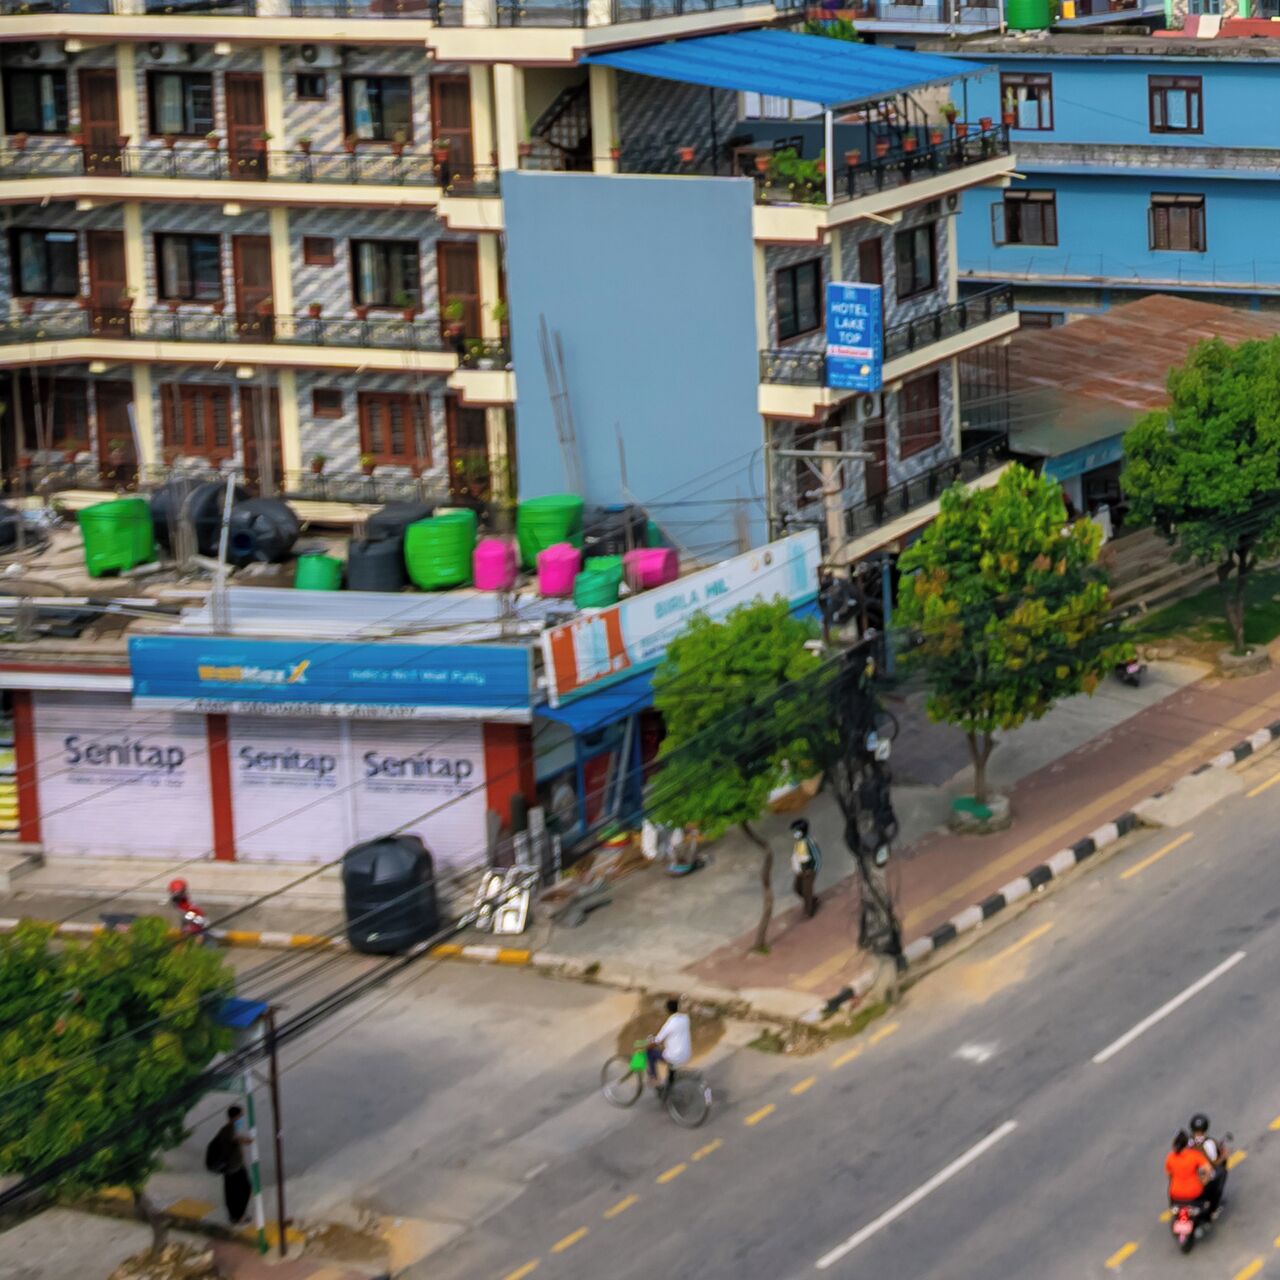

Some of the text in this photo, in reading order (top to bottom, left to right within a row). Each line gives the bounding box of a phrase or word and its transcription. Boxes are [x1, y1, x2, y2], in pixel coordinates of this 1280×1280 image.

[832, 303, 869, 317] HOTEL
[834, 317, 865, 331] LAKE
[839, 331, 862, 344] TOP
[62, 735, 186, 773] Senitap
[239, 745, 337, 777] Senitap
[362, 750, 474, 784] Senitap
